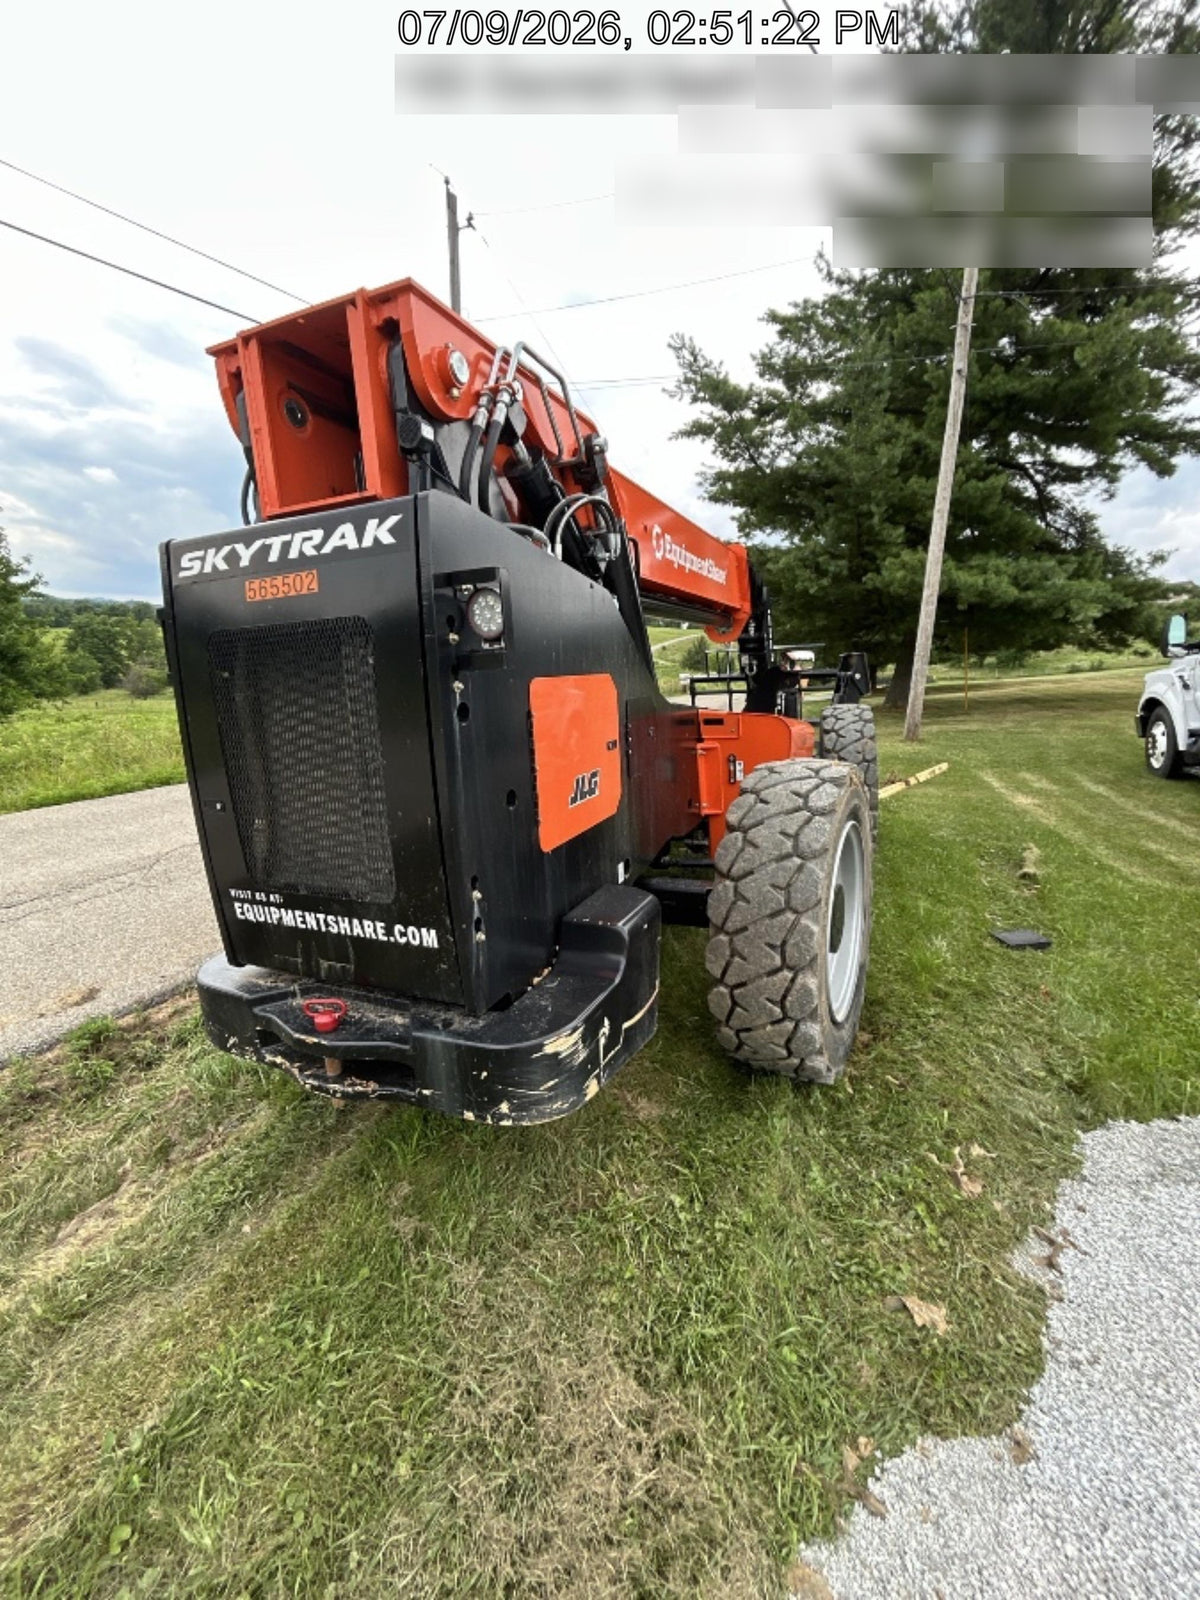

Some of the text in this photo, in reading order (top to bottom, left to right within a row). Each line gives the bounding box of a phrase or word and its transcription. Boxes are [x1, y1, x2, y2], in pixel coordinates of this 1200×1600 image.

[178, 514, 402, 578] SKYTRAK
[248, 571, 315, 600] 565502
[569, 771, 600, 807] JLG
[234, 902, 439, 948] EQUIPMENTSHARE.COM
